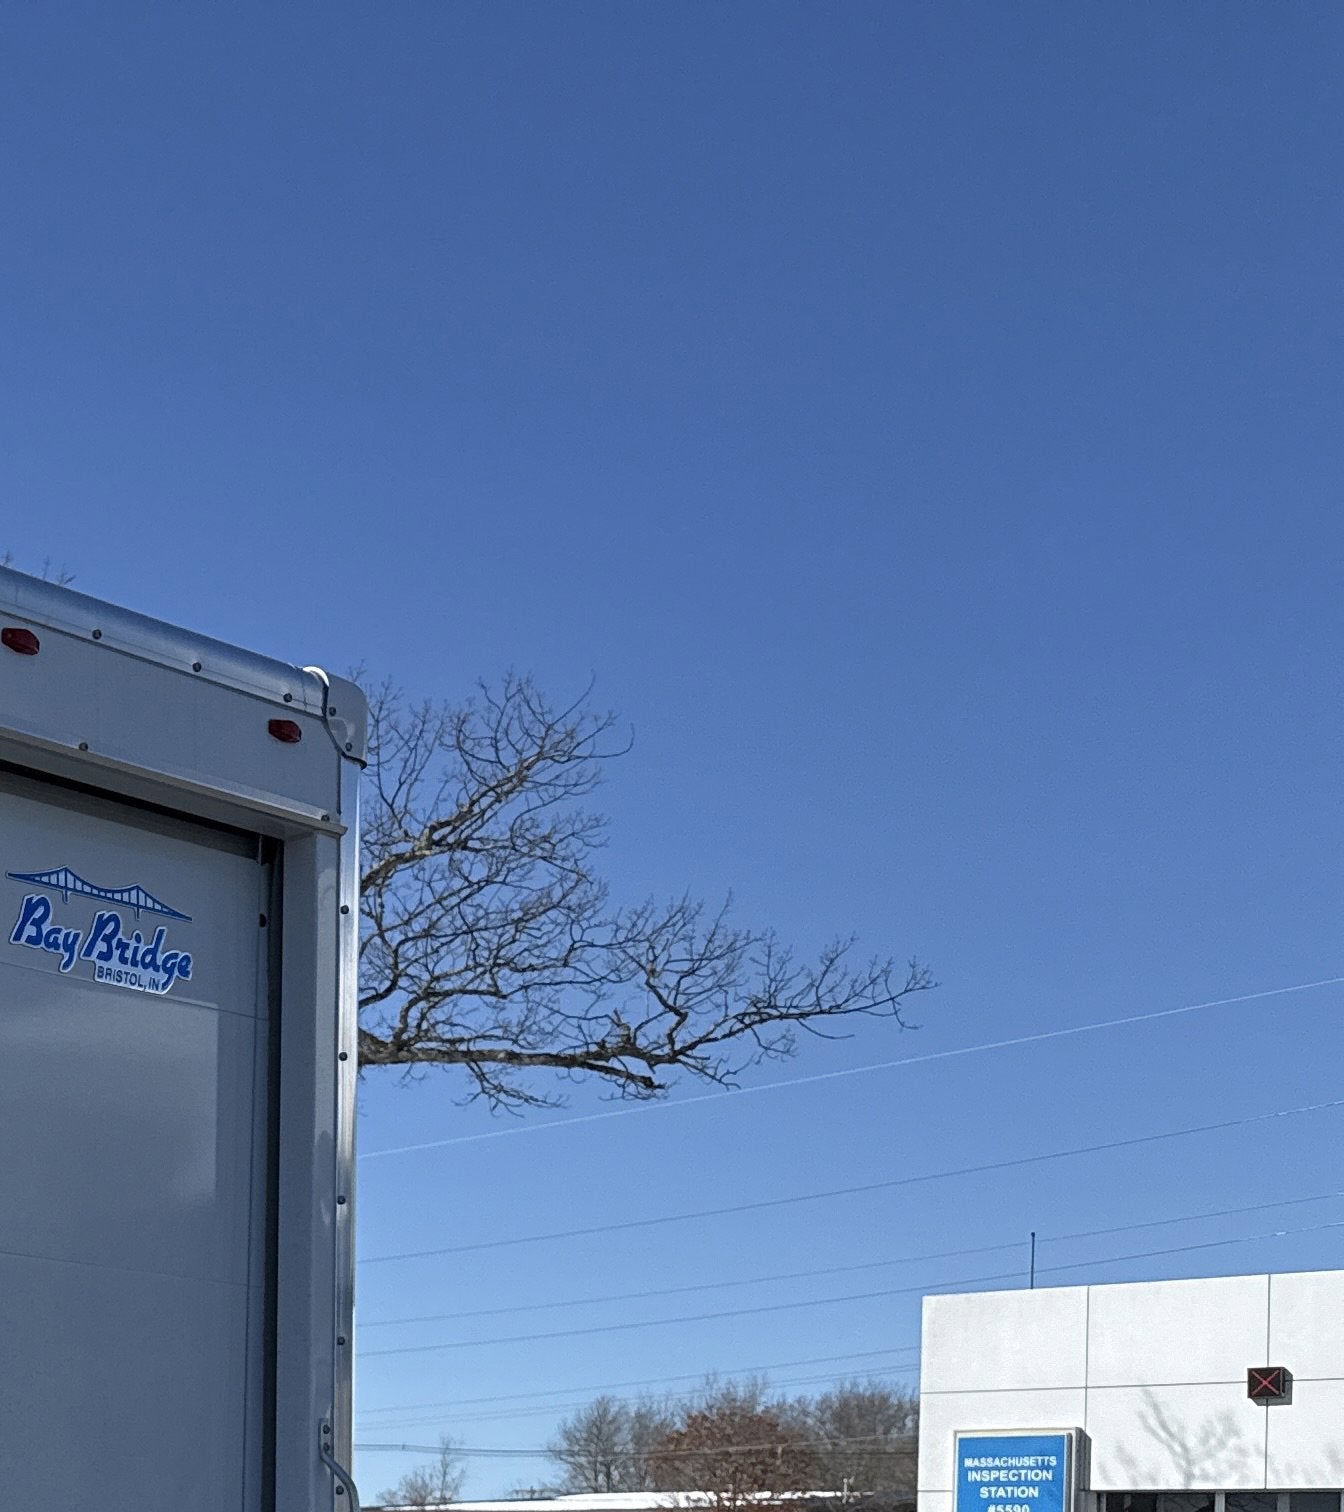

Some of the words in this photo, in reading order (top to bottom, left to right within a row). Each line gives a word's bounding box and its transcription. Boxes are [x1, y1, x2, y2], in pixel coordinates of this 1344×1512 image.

[12, 895, 81, 972] Bay
[81, 911, 192, 992] Bridge
[96, 965, 148, 991] BRISTOL,
[148, 977, 162, 991] IN
[964, 1456, 1057, 1468] MASSACHUSETTS
[967, 1469, 1053, 1482] INSPECTION
[979, 1486, 1039, 1498] STATION
